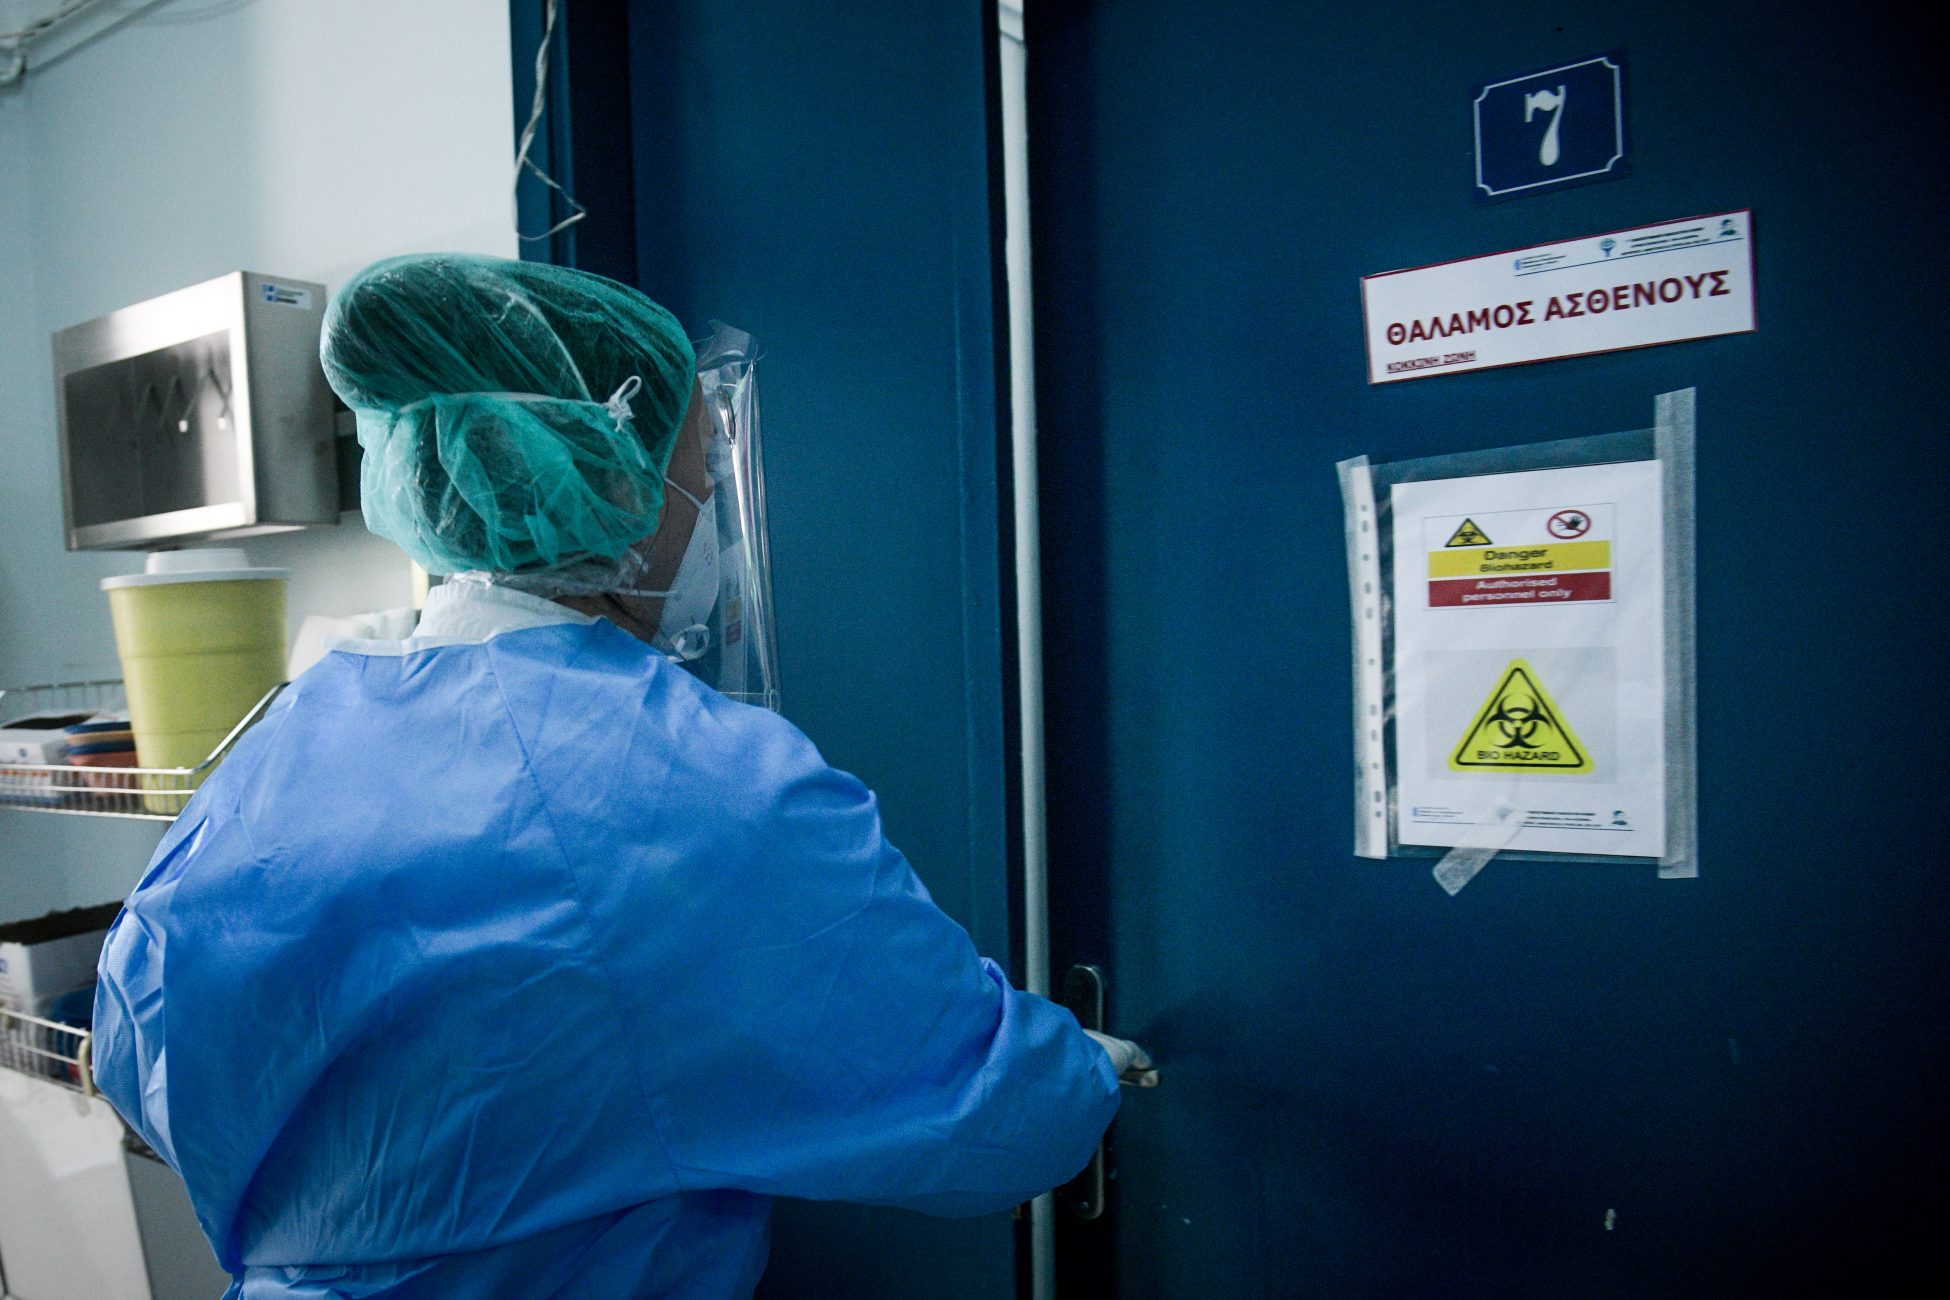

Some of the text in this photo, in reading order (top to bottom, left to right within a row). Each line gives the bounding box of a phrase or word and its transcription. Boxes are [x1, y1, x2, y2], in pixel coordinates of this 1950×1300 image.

[1524, 85, 1566, 166] 7
[1387, 270, 1730, 345] ΘΑΛΑΜΟΣ ΑΣΘΕΝΟΥΣ
[1483, 549, 1548, 561] Danger
[1480, 561, 1553, 572] Biohazard
[1476, 578, 1558, 589] Authorised
[1462, 589, 1573, 602] personnel only
[1477, 751, 1560, 760] BIO HAZARD
